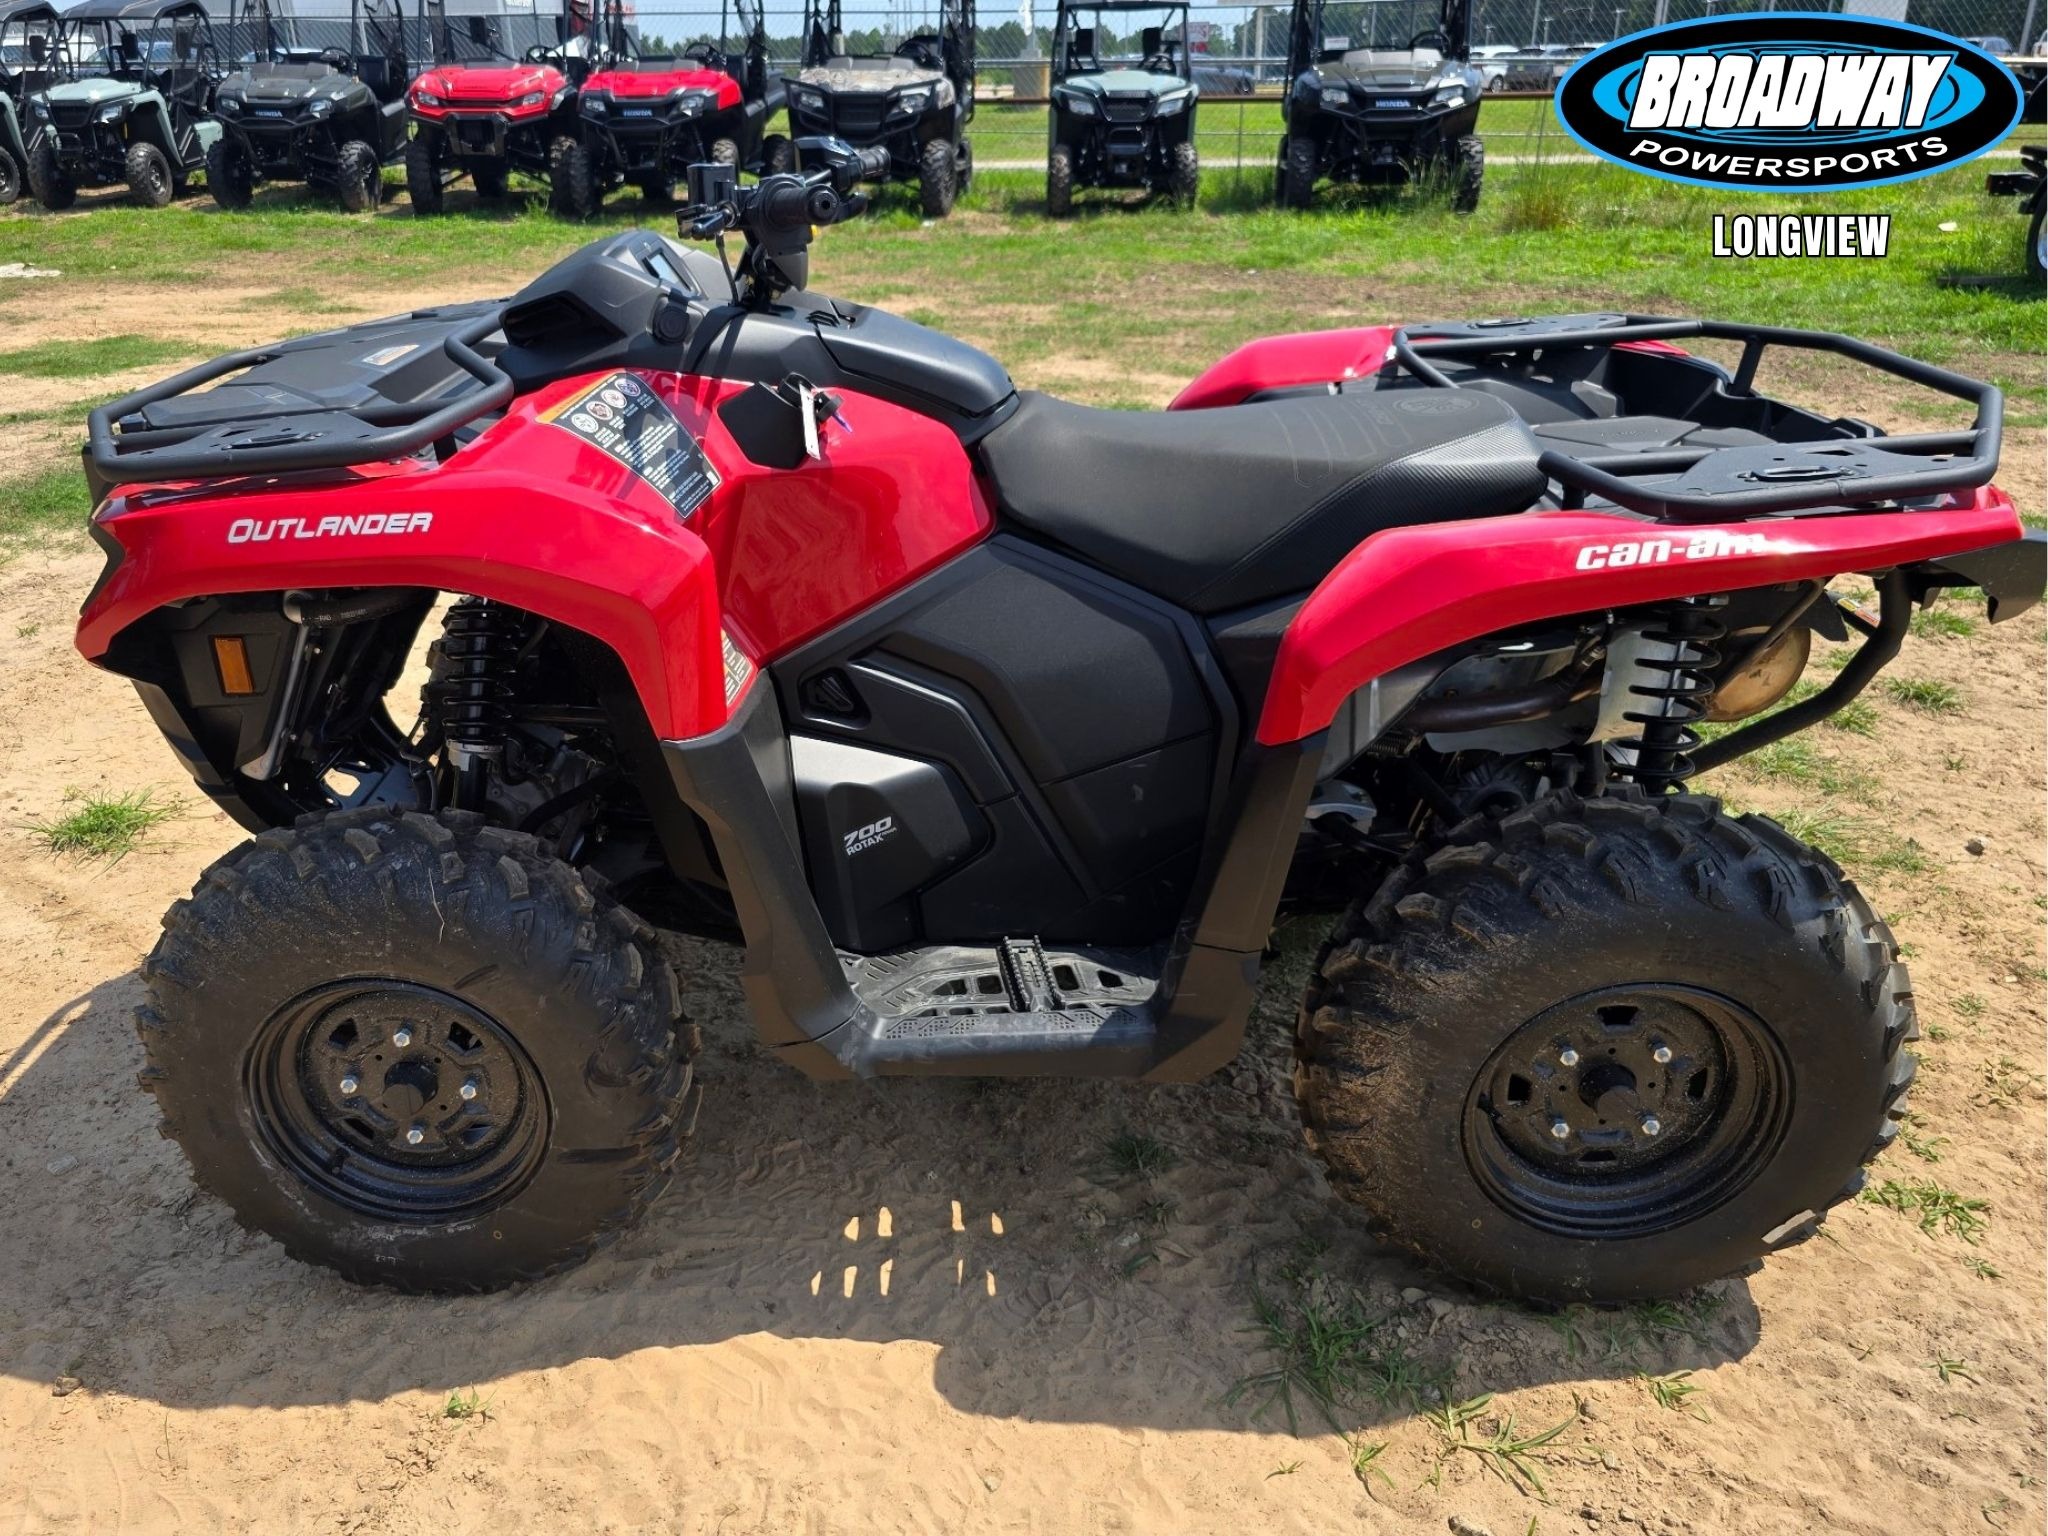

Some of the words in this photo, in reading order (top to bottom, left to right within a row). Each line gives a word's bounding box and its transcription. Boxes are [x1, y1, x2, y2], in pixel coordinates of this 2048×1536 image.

[227, 512, 433, 544] OUTLANDER
[844, 816, 892, 847] 700
[846, 833, 884, 856] ROTAX
